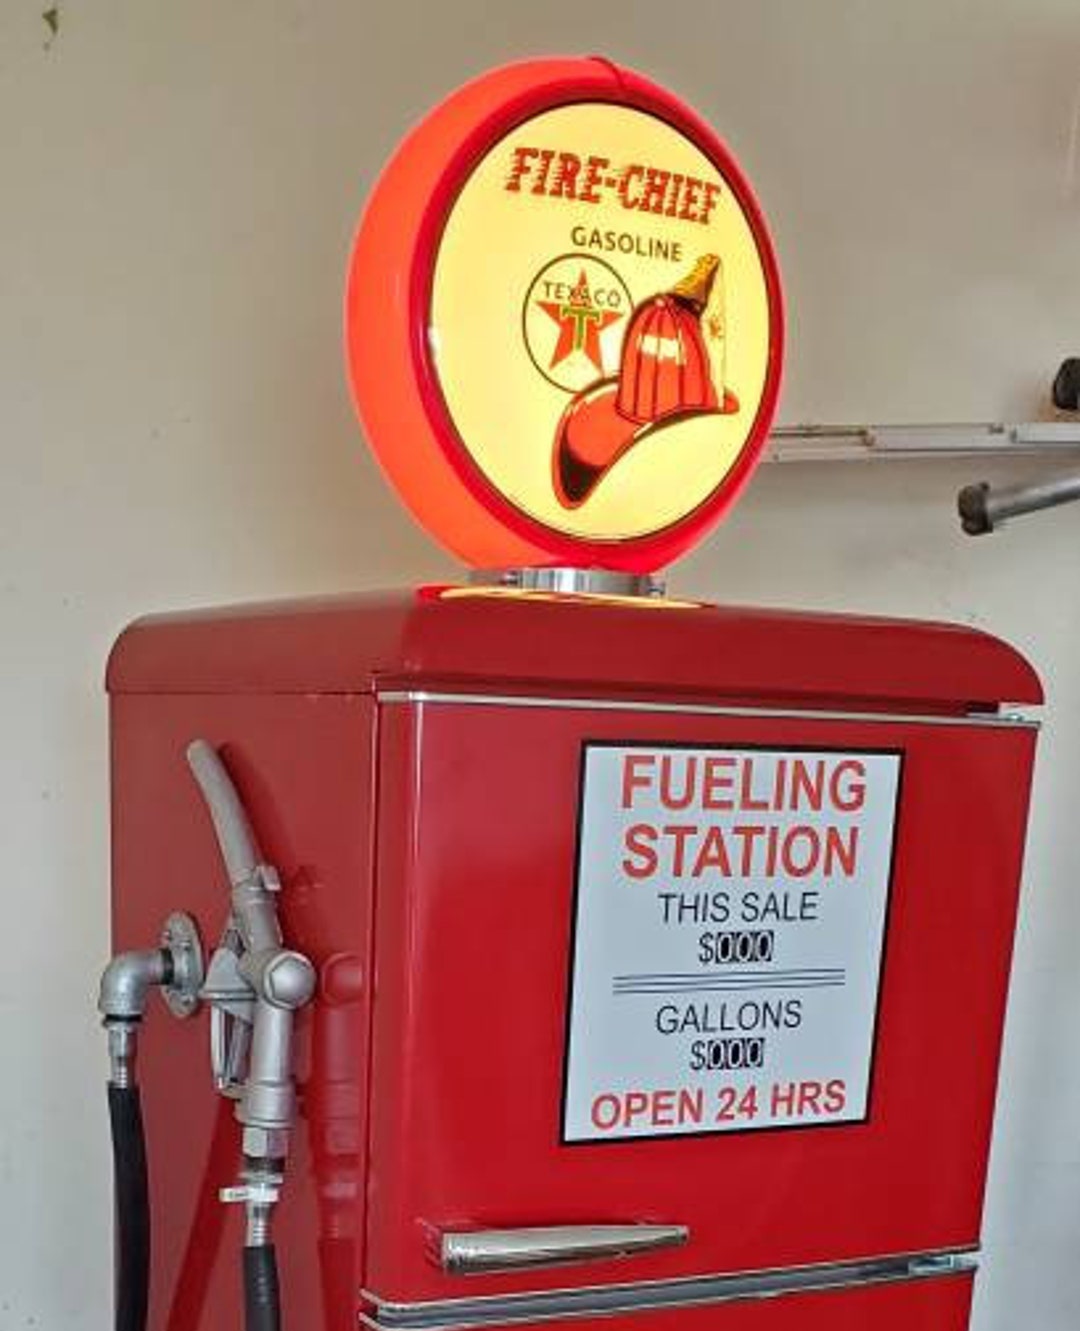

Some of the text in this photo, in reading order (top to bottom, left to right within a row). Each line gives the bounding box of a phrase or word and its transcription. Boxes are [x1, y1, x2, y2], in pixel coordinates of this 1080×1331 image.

[505, 147, 721, 225] FIRE-CHIEF
[571, 226, 682, 262] GASOLINE
[543, 281, 621, 308] TEXACO
[562, 306, 600, 350] T
[621, 755, 867, 812] FUELING
[622, 824, 859, 879] STATION
[658, 892, 819, 923] THIS SALE
[699, 930, 774, 965] $000
[656, 1000, 802, 1035] GALLONS
[690, 1037, 766, 1071] $000
[591, 1080, 846, 1130] OPEN 24 HRS
